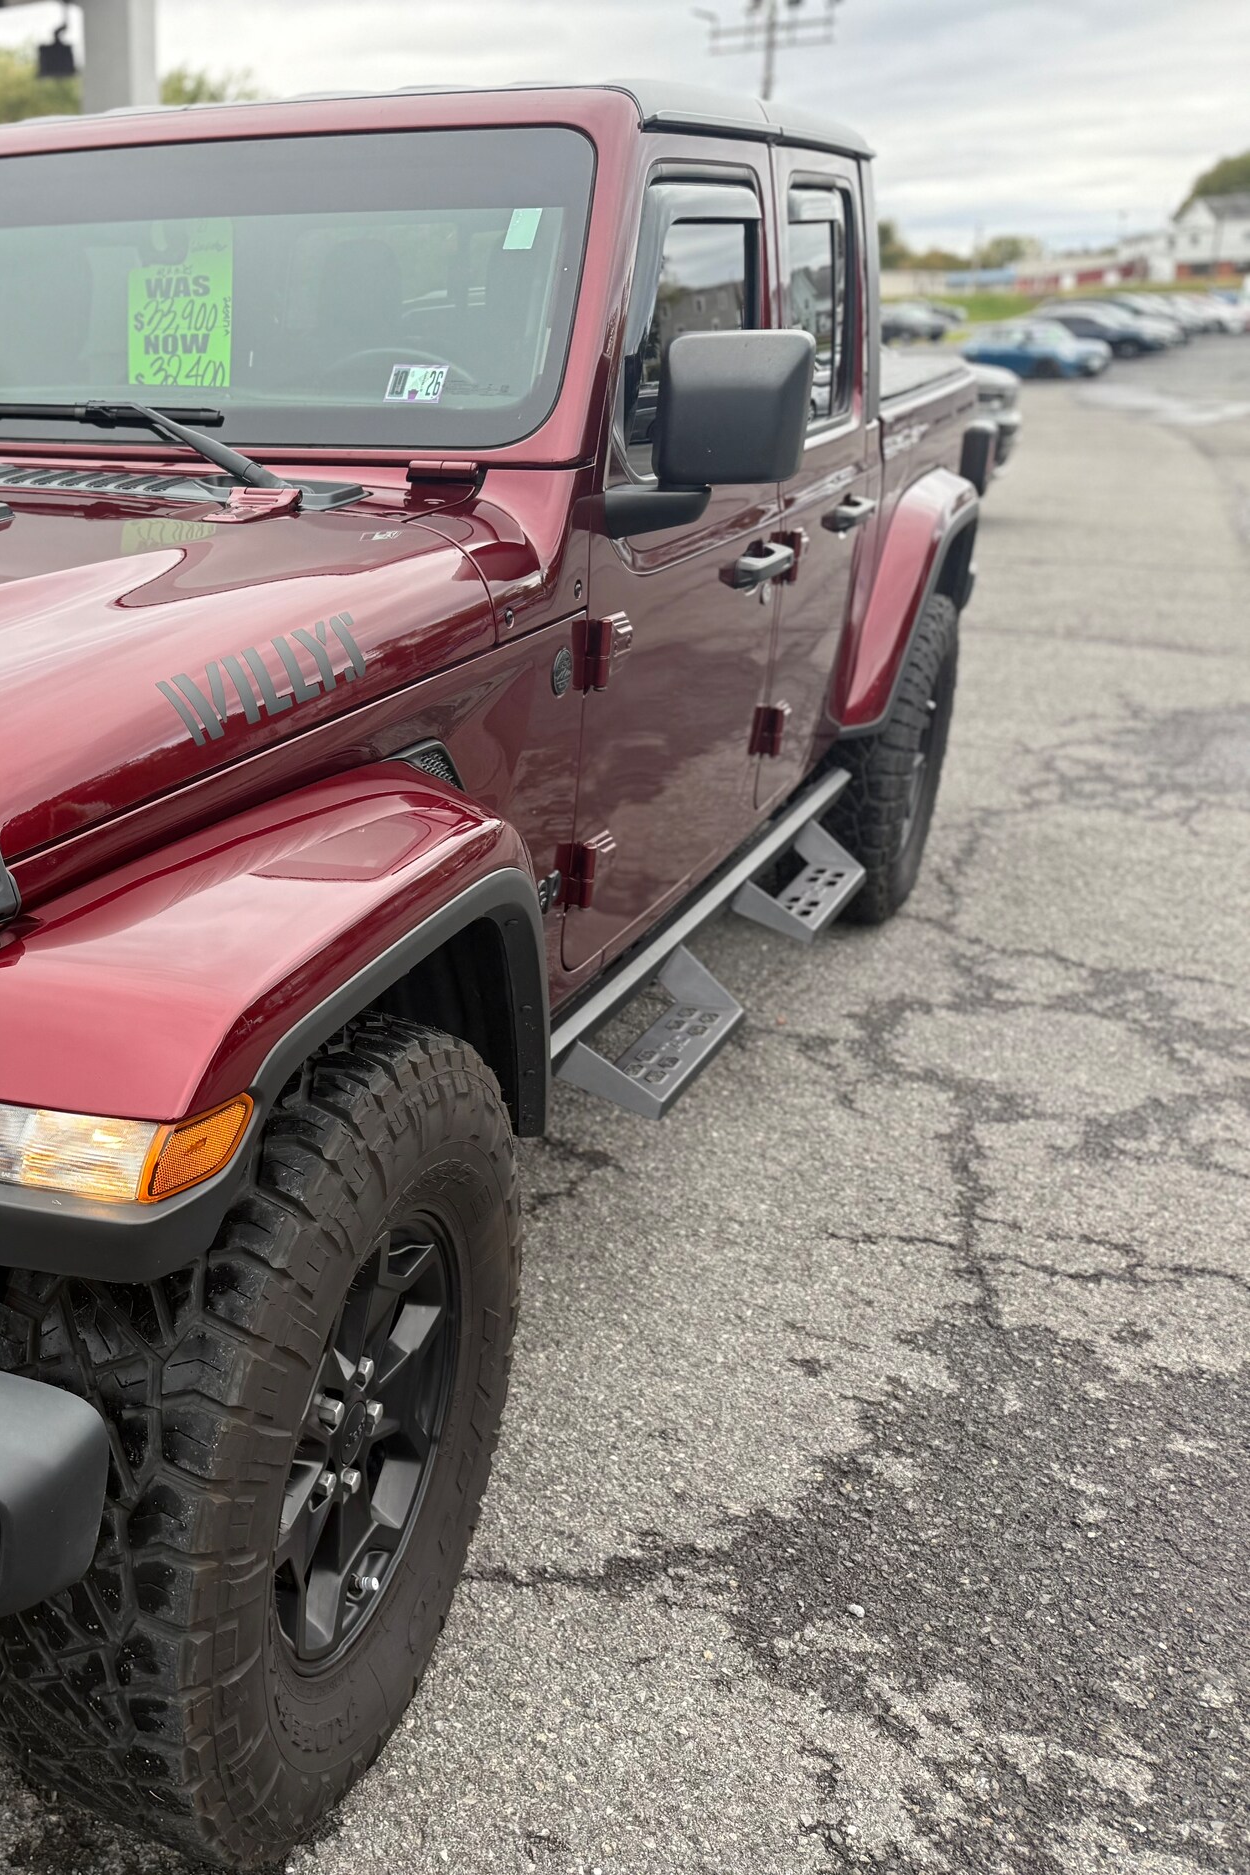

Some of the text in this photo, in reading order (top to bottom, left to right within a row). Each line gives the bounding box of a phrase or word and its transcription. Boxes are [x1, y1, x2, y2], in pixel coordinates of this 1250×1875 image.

[144, 275, 211, 299] WAS
[143, 333, 210, 356] NOW
[425, 370, 444, 396] 26
[155, 611, 366, 746] WILLYS
